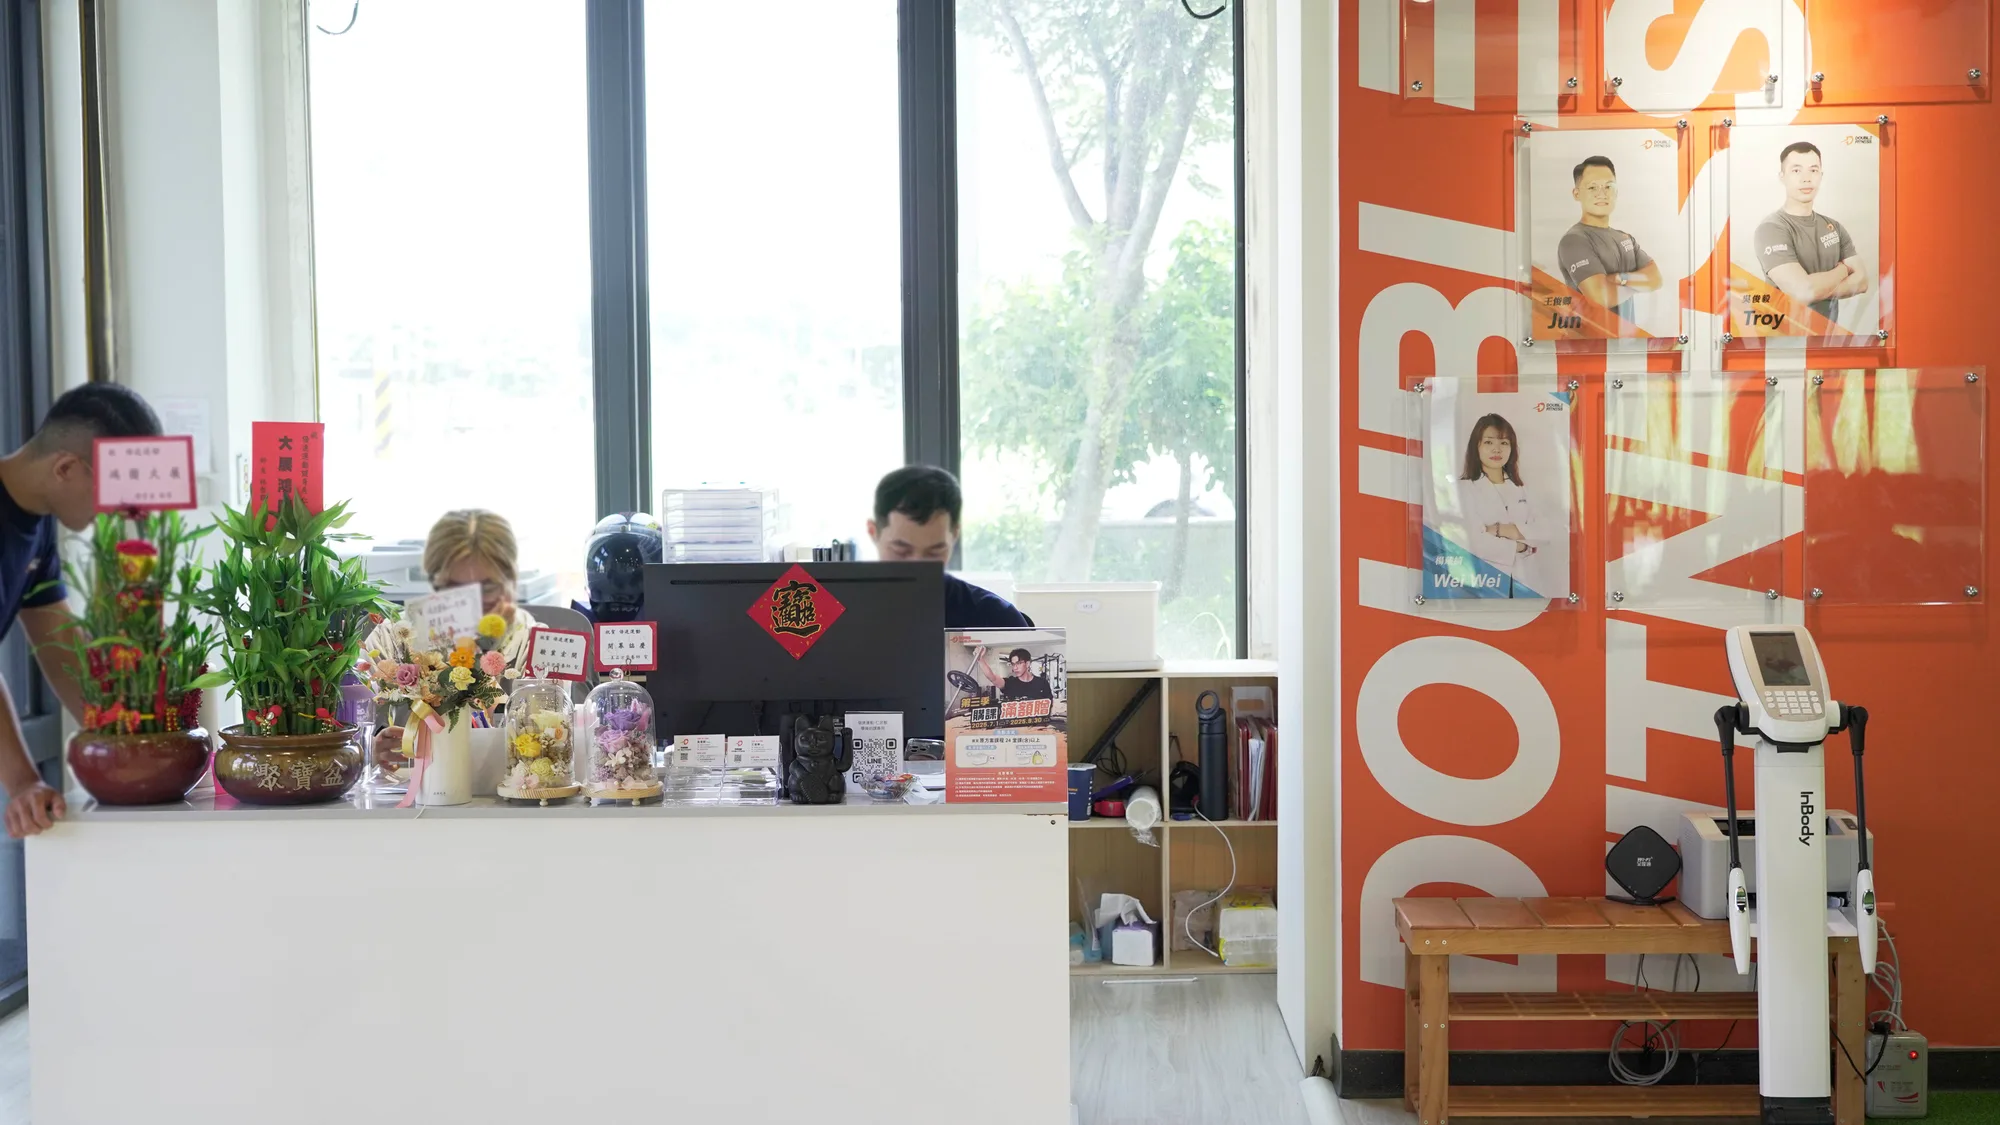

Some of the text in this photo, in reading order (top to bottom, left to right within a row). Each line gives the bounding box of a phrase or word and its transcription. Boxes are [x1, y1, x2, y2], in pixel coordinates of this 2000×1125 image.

[1547, 312, 1582, 329] Jun
[1743, 310, 1785, 330] Troy
[1434, 573, 1502, 588] Wei Wei
[961, 696, 990, 709] 第三季
[973, 700, 1050, 721] 購課 滿額贈
[254, 761, 348, 792] 聚寶盆
[1798, 791, 1815, 846] InBody
